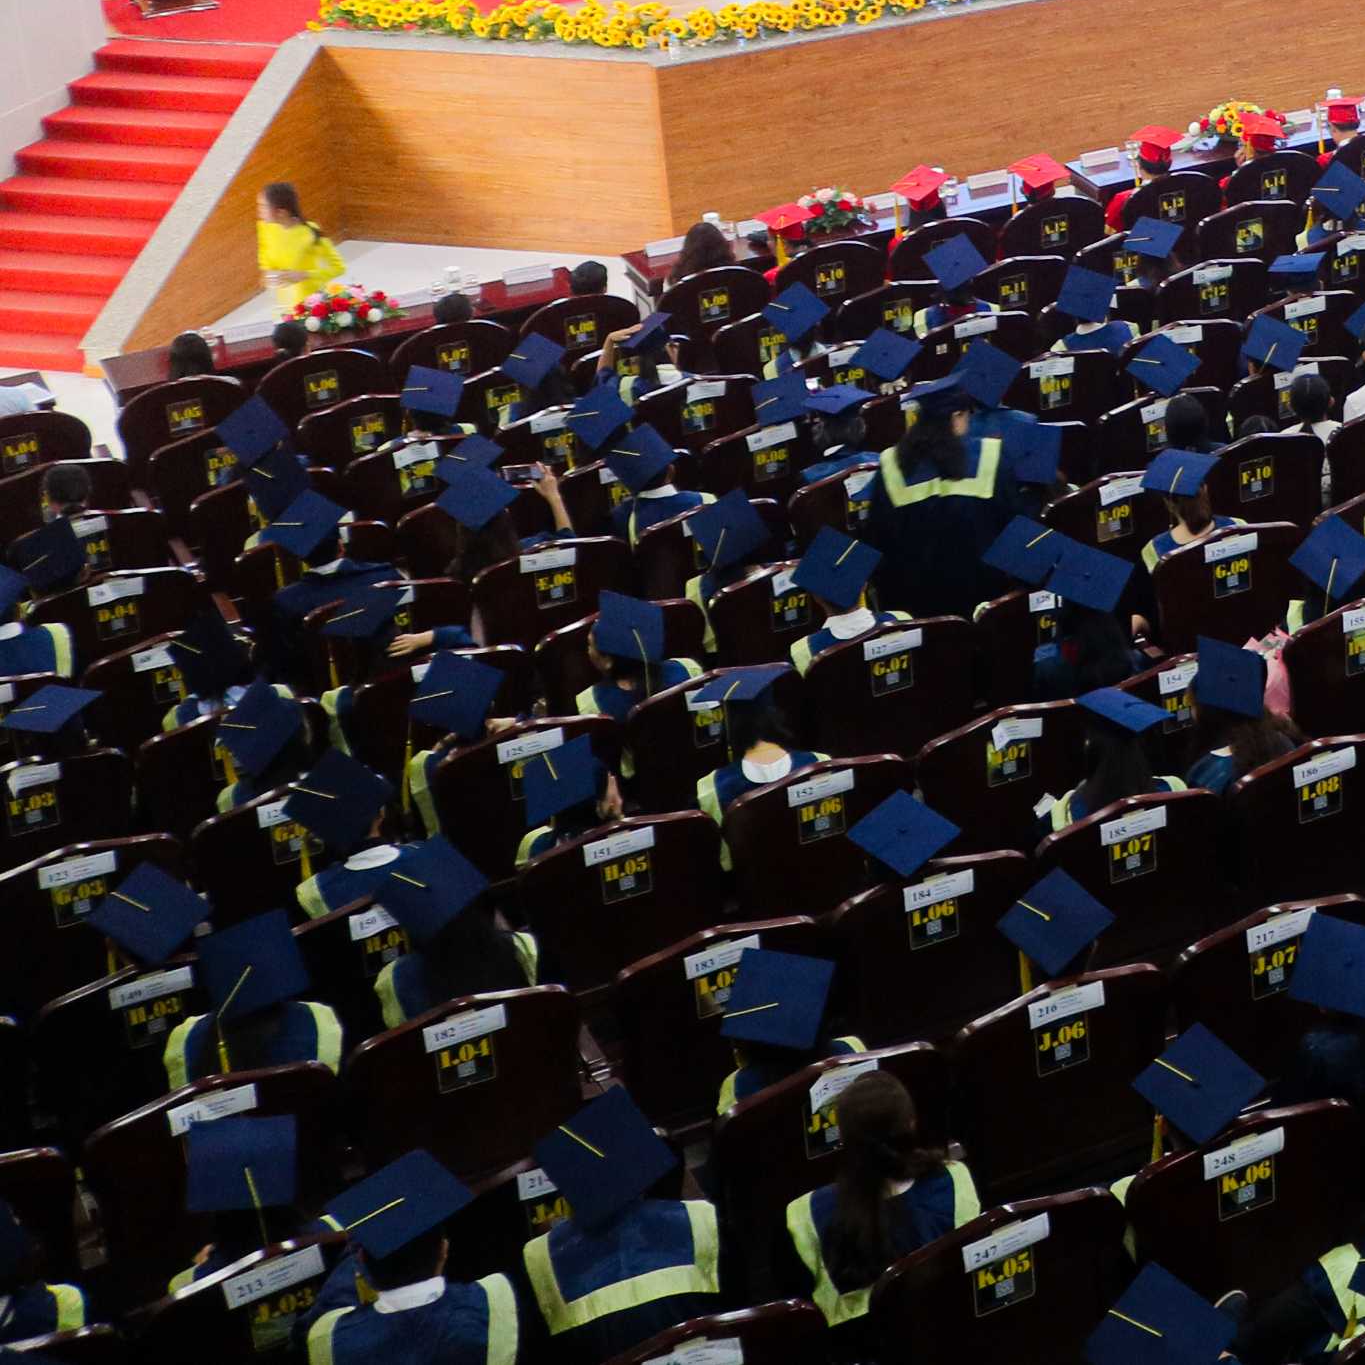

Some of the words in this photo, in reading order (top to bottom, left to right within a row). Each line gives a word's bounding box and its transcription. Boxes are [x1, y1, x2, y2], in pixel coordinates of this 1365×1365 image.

[1242, 466, 1271, 481] F.10
[1216, 559, 1248, 578] G.09
[873, 657, 907, 675] G.07
[1303, 778, 1339, 799] I.08
[802, 799, 841, 820] H.06
[1114, 835, 1151, 858] I.07
[605, 860, 647, 880] H.05
[911, 891, 931, 903] 184
[913, 902, 954, 925] I.06
[1254, 933, 1274, 945] 217
[1255, 946, 1296, 974] J.07
[432, 1028, 456, 1041] 182
[1040, 1023, 1085, 1050] J.06
[441, 1040, 489, 1067] I.04
[1211, 1155, 1236, 1171] 248
[1223, 1161, 1270, 1193] K.06
[973, 1247, 998, 1263] 247
[979, 1253, 1030, 1288] K.05
